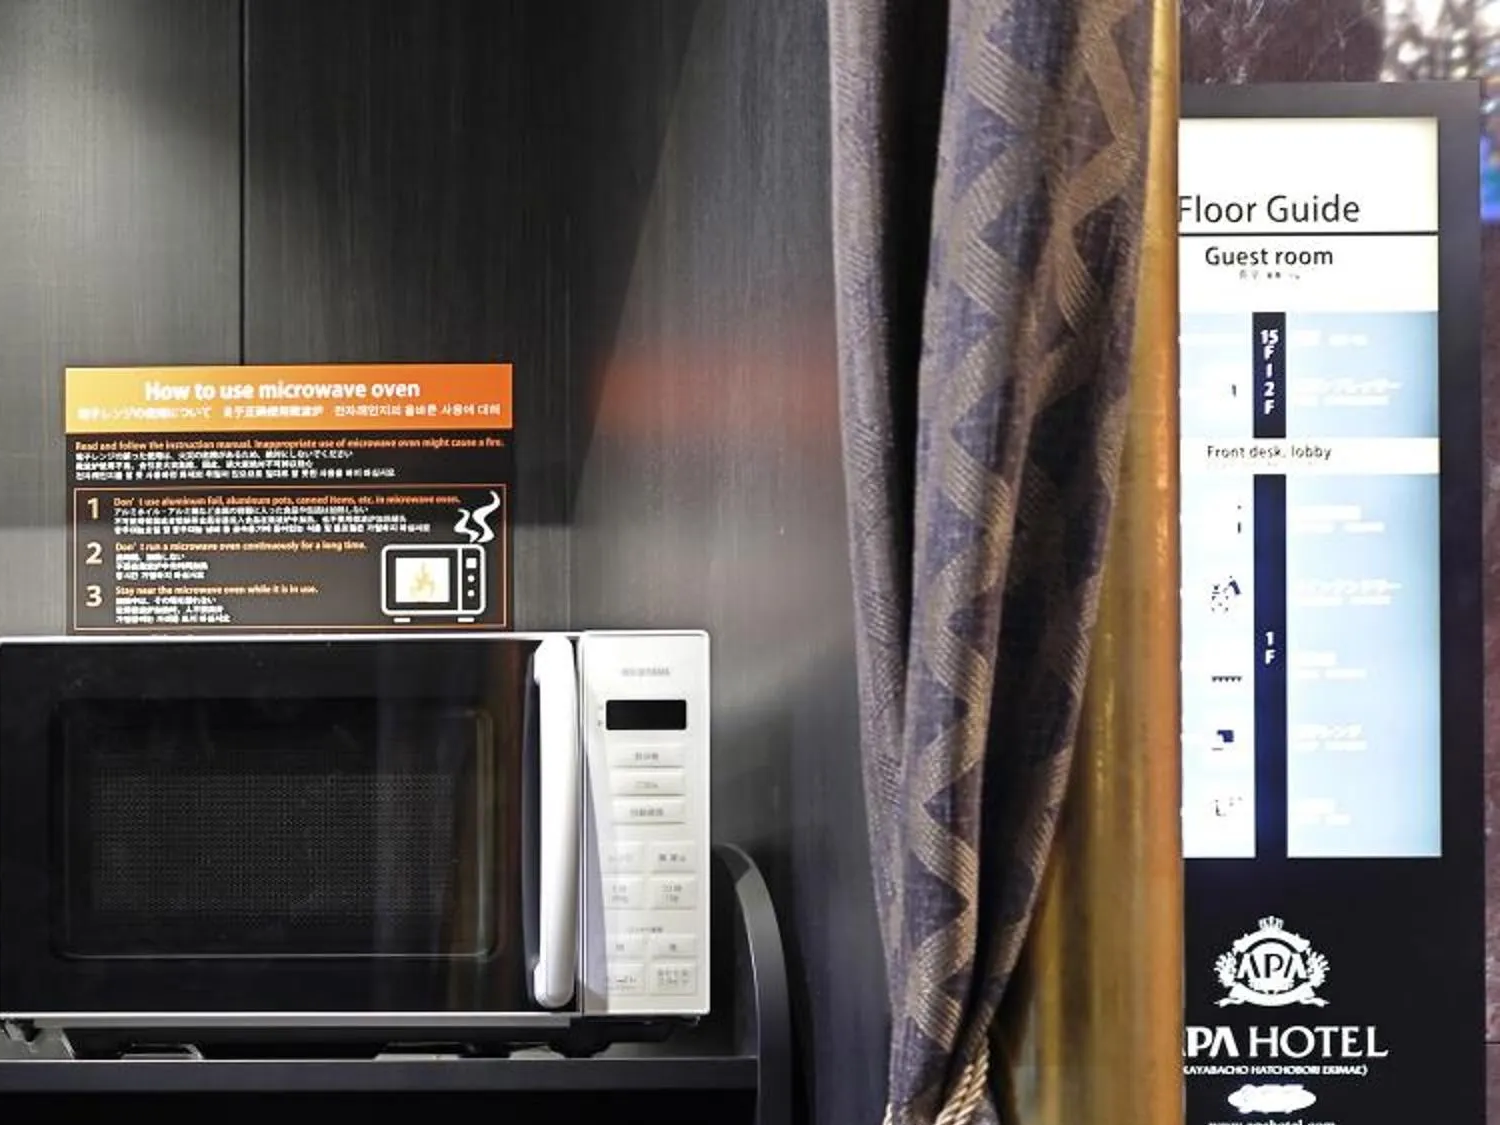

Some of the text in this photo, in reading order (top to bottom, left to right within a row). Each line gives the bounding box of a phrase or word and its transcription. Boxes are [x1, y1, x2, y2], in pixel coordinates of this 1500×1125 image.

[1178, 193, 1360, 224] Floor Guide
[1205, 246, 1334, 266] Guest room
[145, 380, 421, 401] How to use microwave oven
[347, 438, 397, 448] microwave
[1207, 445, 1245, 458] Front
[1290, 444, 1332, 461] lobby
[87, 497, 100, 520] 1
[85, 542, 102, 564] 2
[85, 585, 102, 607] 3
[173, 585, 222, 594] microwave
[1181, 1025, 1389, 1058] PA HOTEL
